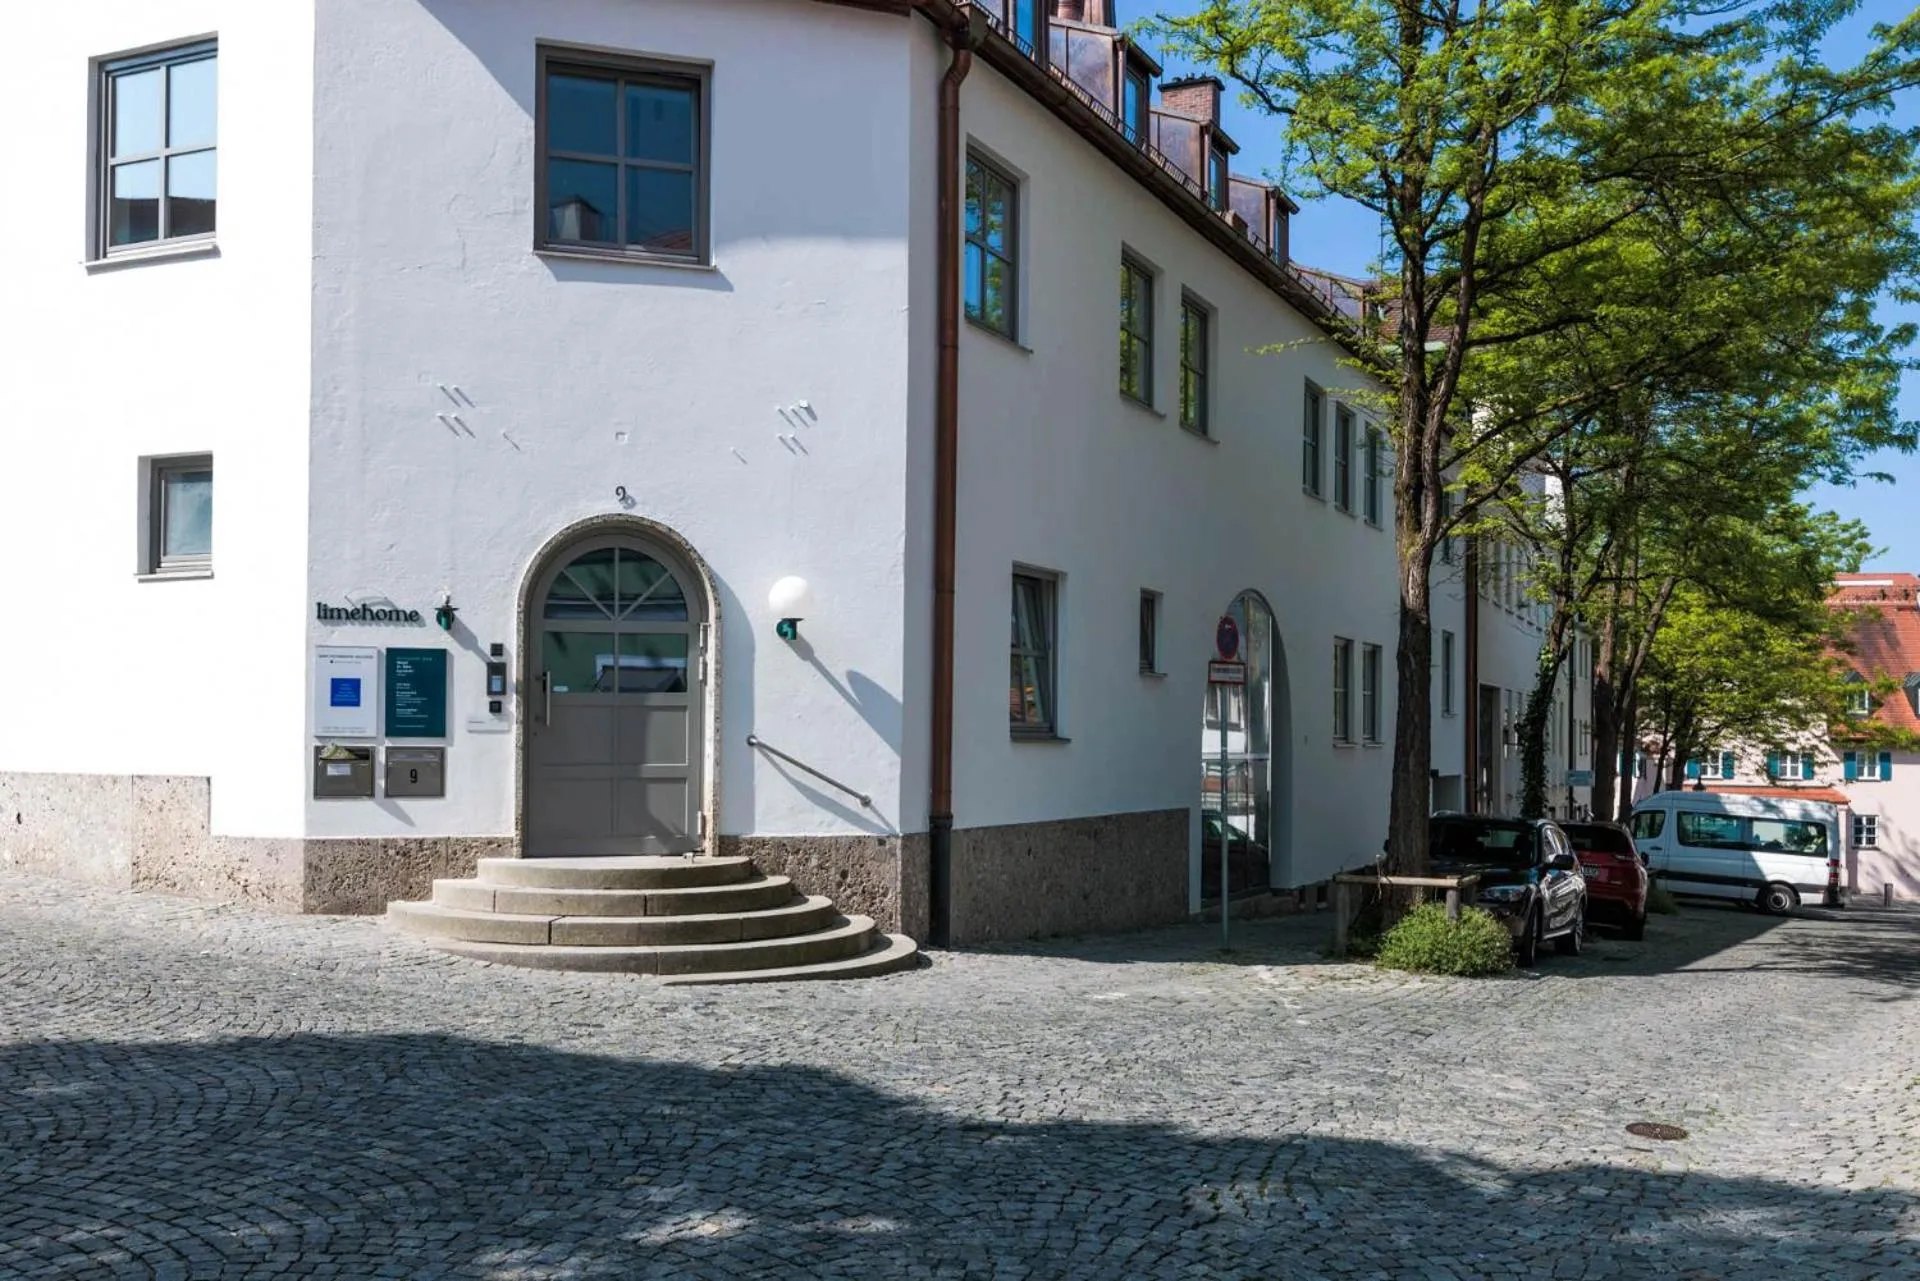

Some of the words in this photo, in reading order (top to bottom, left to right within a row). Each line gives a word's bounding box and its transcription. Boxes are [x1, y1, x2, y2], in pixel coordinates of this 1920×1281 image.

[615, 485, 626, 502] 9
[316, 602, 421, 622] limehome
[409, 768, 418, 784] 9
